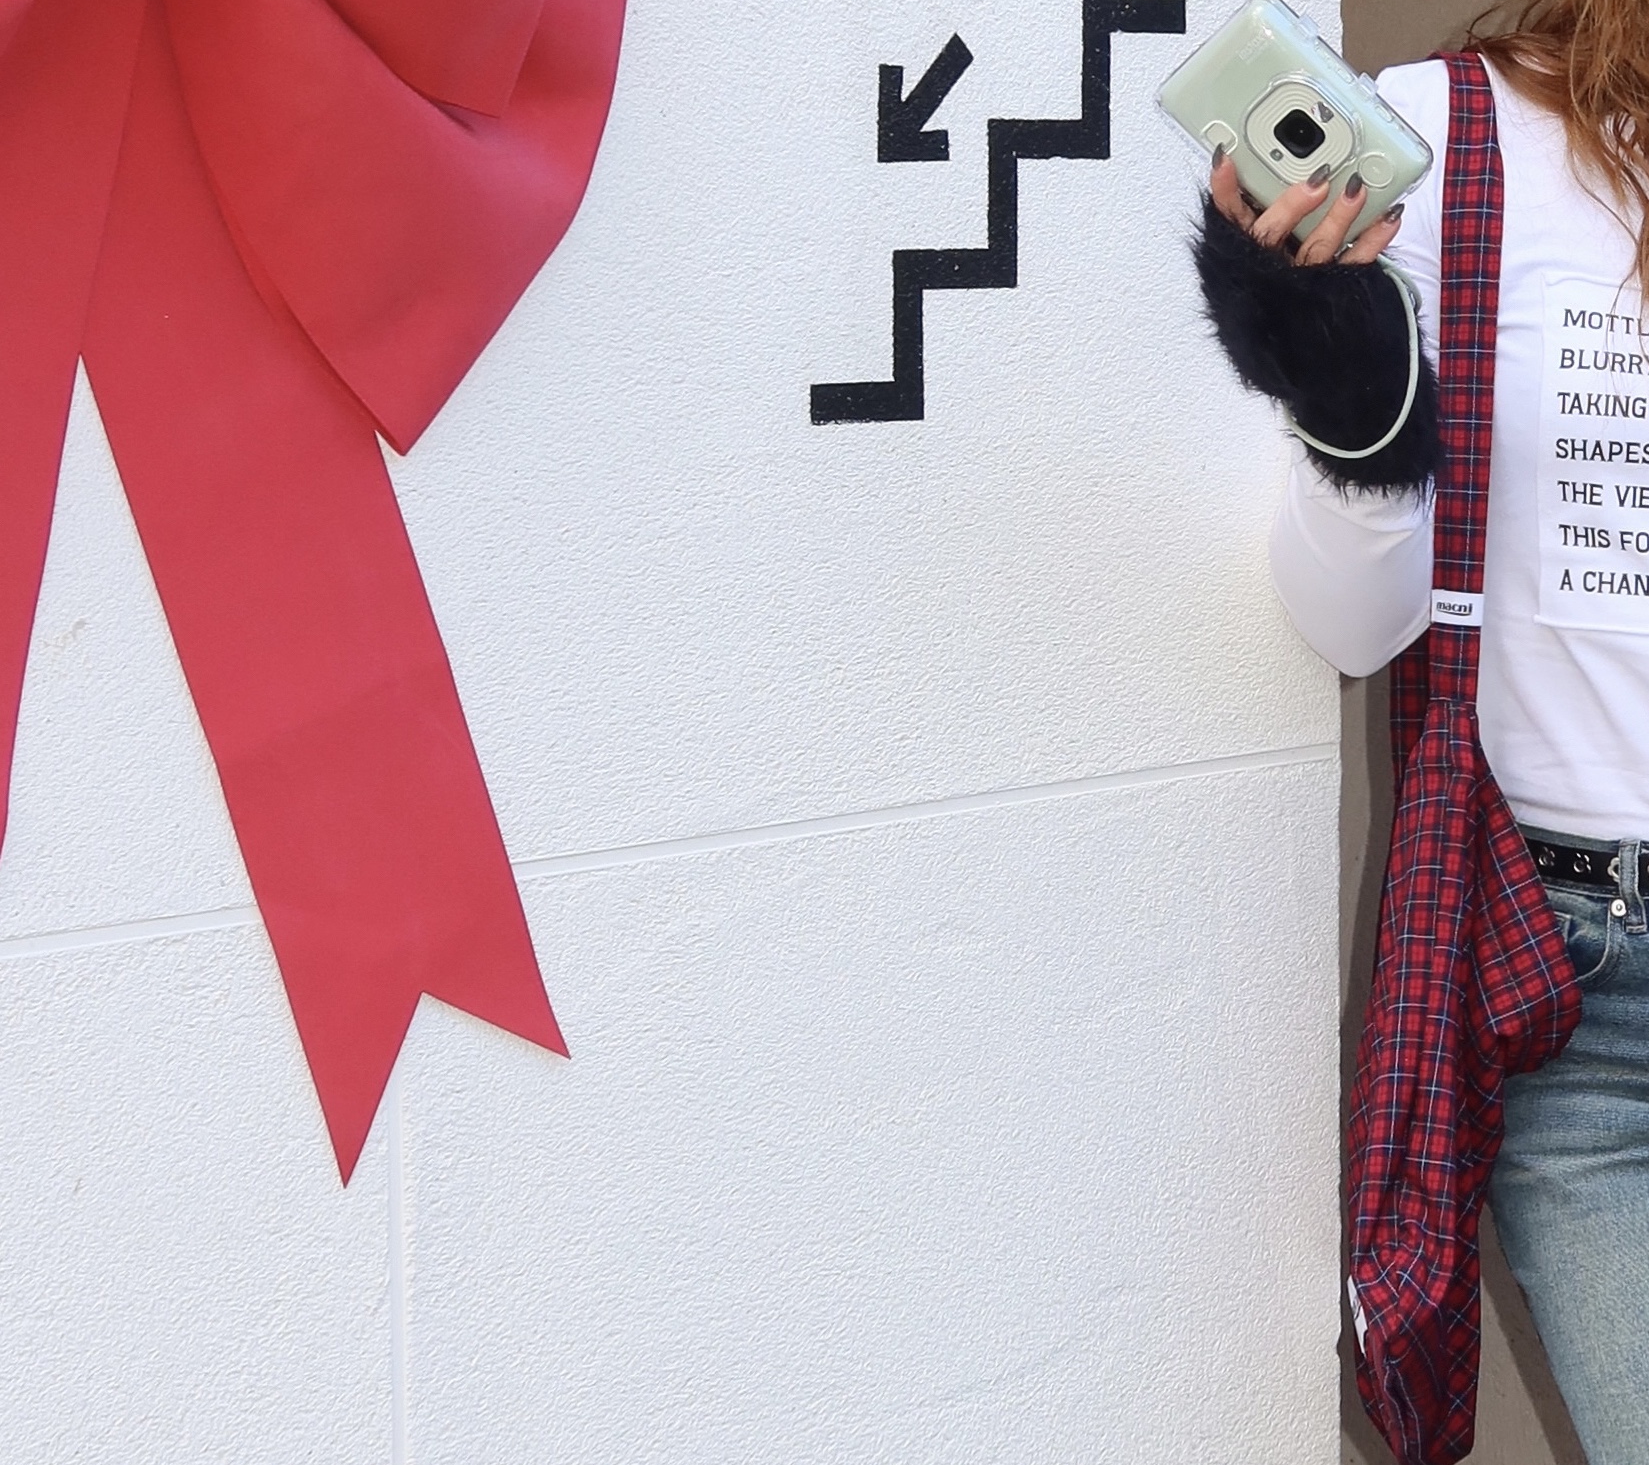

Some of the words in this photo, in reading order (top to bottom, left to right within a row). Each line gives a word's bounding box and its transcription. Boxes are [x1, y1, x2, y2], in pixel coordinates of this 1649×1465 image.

[1557, 392, 1648, 420] TAKING
[1557, 480, 1604, 507] THE
[1558, 523, 1611, 549] THIS
[1559, 569, 1574, 591] A
